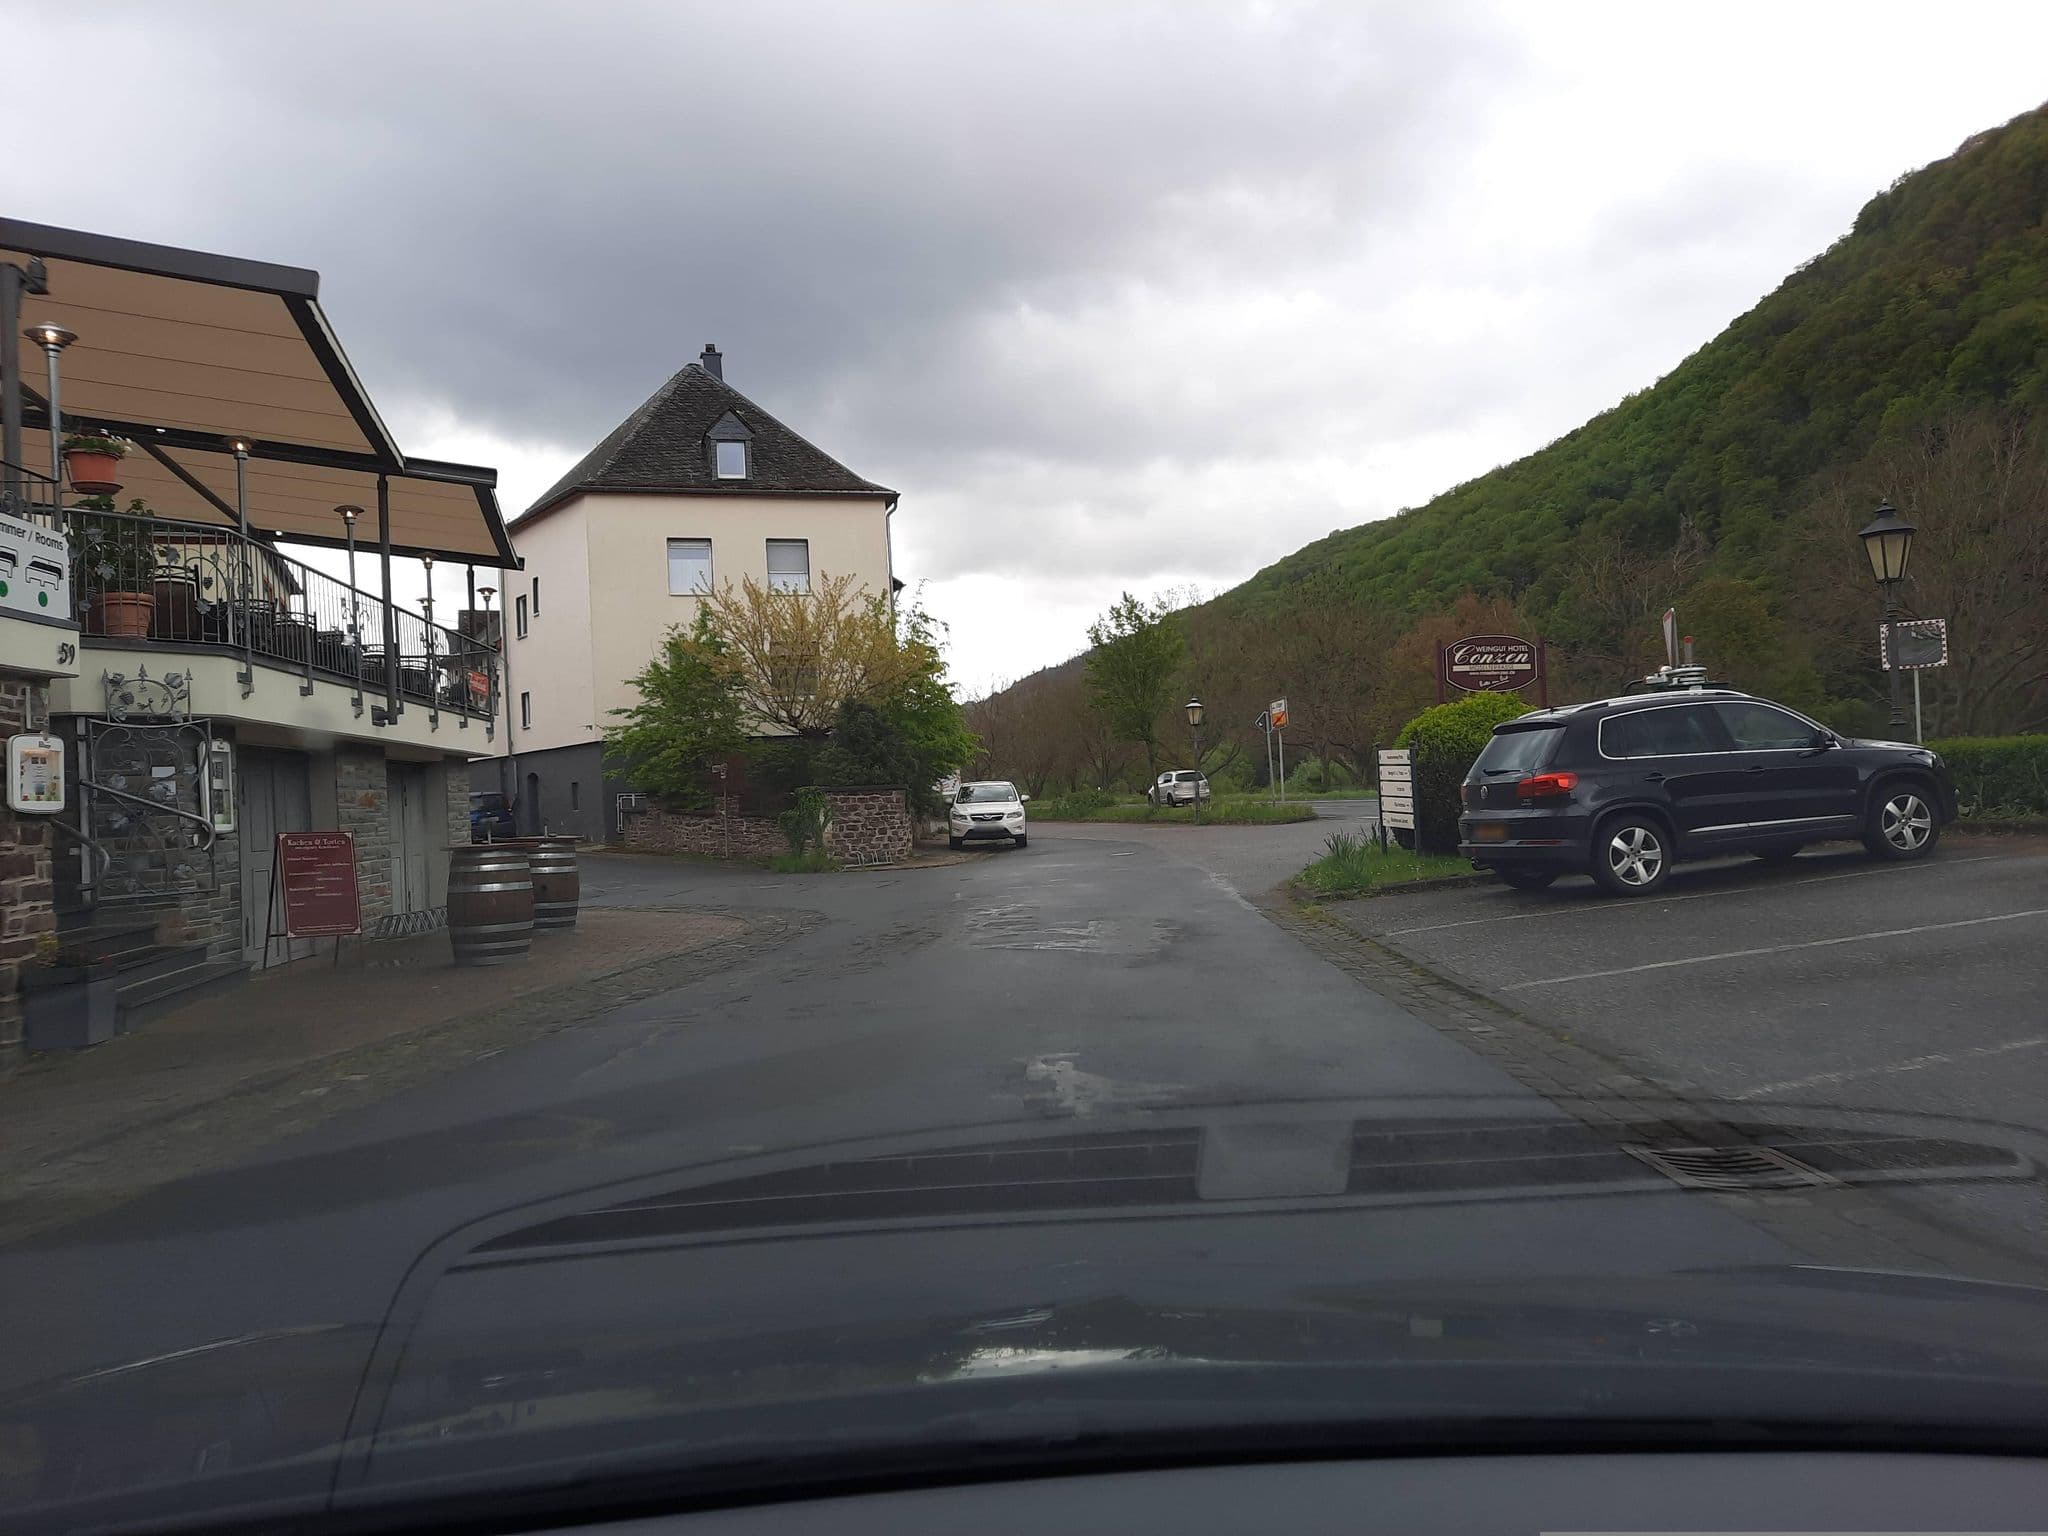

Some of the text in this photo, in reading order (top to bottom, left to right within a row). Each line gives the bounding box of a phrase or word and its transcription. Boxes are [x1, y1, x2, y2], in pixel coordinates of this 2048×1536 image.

[35, 532, 64, 551] Rooms
[59, 642, 76, 665] 59
[1453, 645, 1529, 664] Conzen
